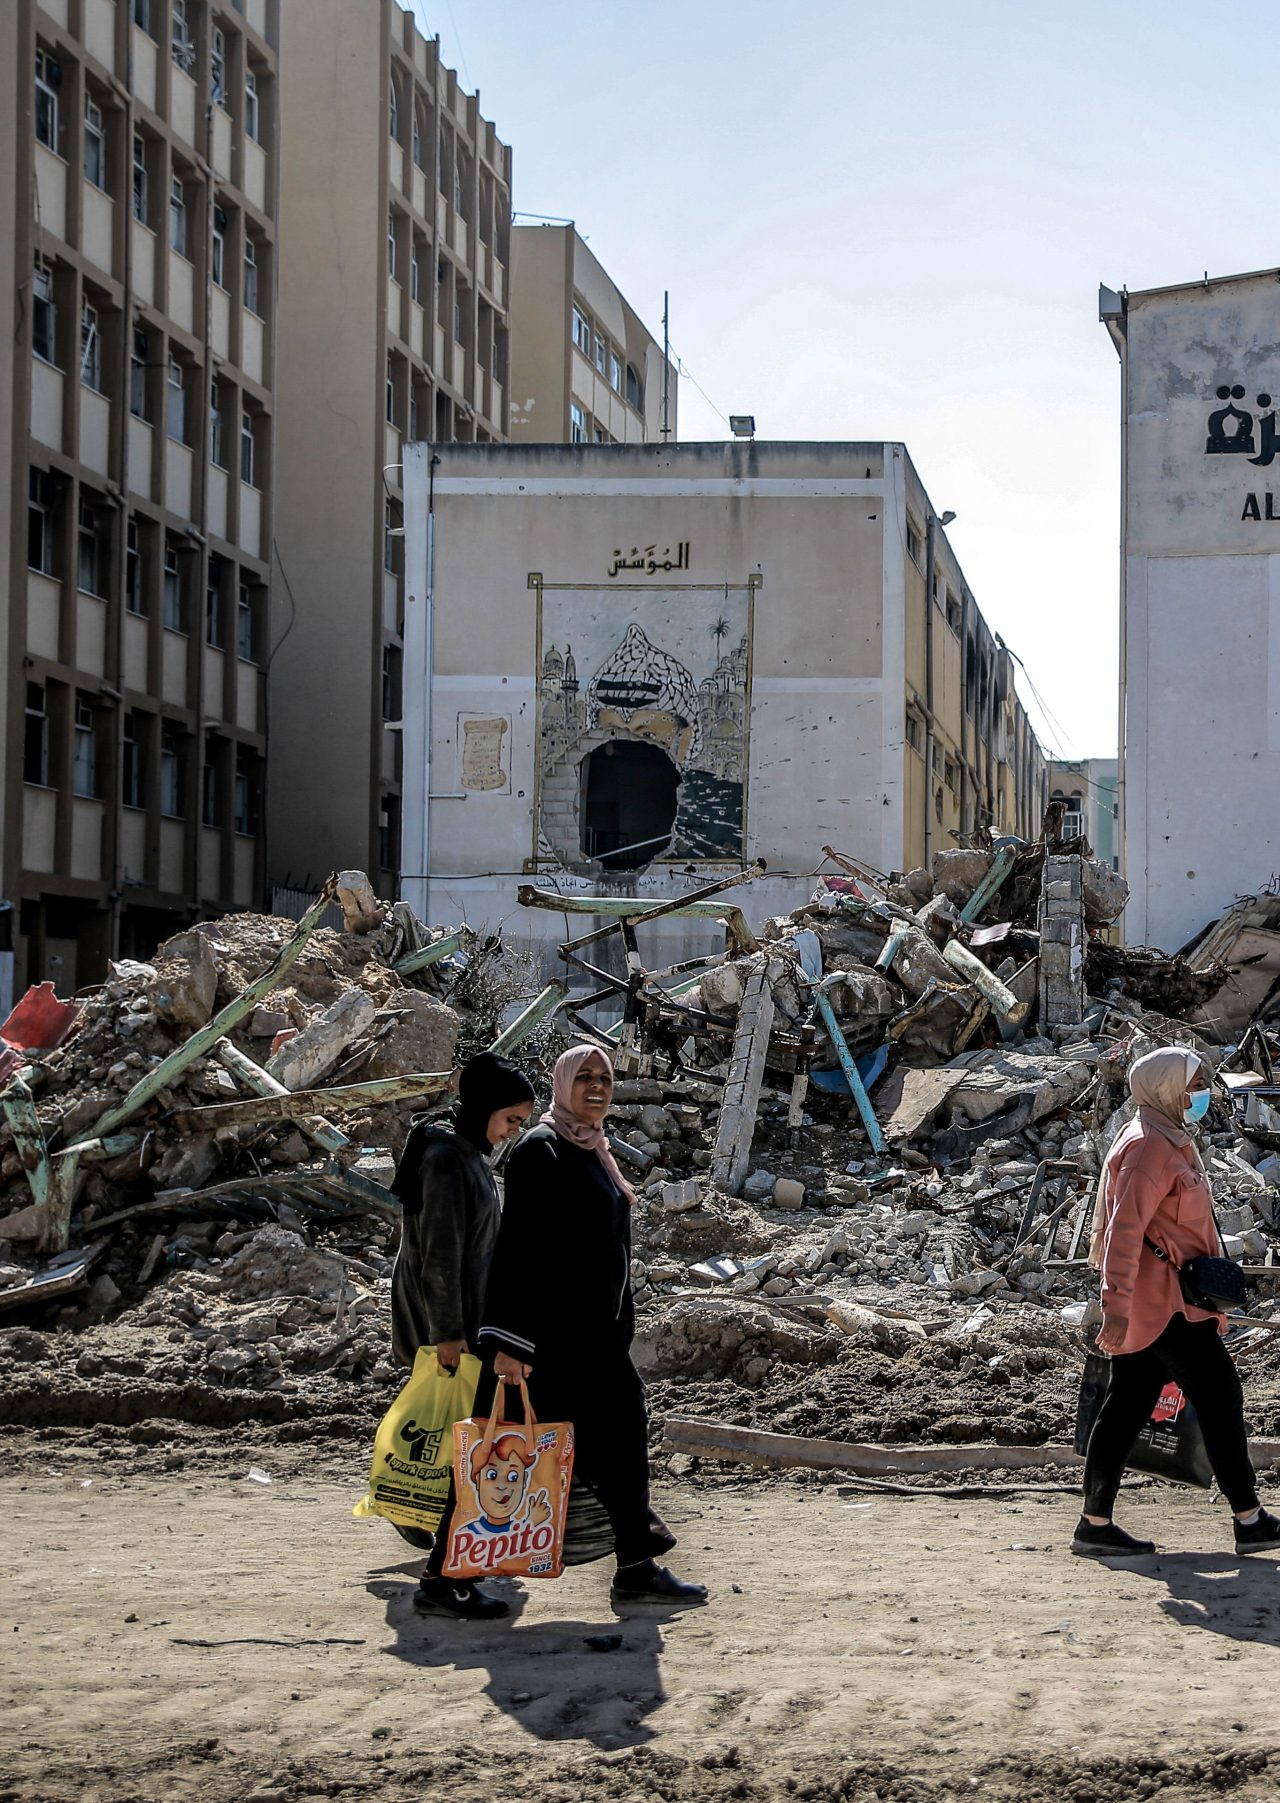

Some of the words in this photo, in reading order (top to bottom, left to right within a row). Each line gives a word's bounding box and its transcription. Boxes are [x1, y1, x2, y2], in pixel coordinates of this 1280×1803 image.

[389, 1458, 418, 1476] spark
[417, 1465, 448, 1481] sport
[450, 1523, 553, 1567] Pepito
[531, 1554, 551, 1563] SINCE
[529, 1562, 552, 1572] 1932
